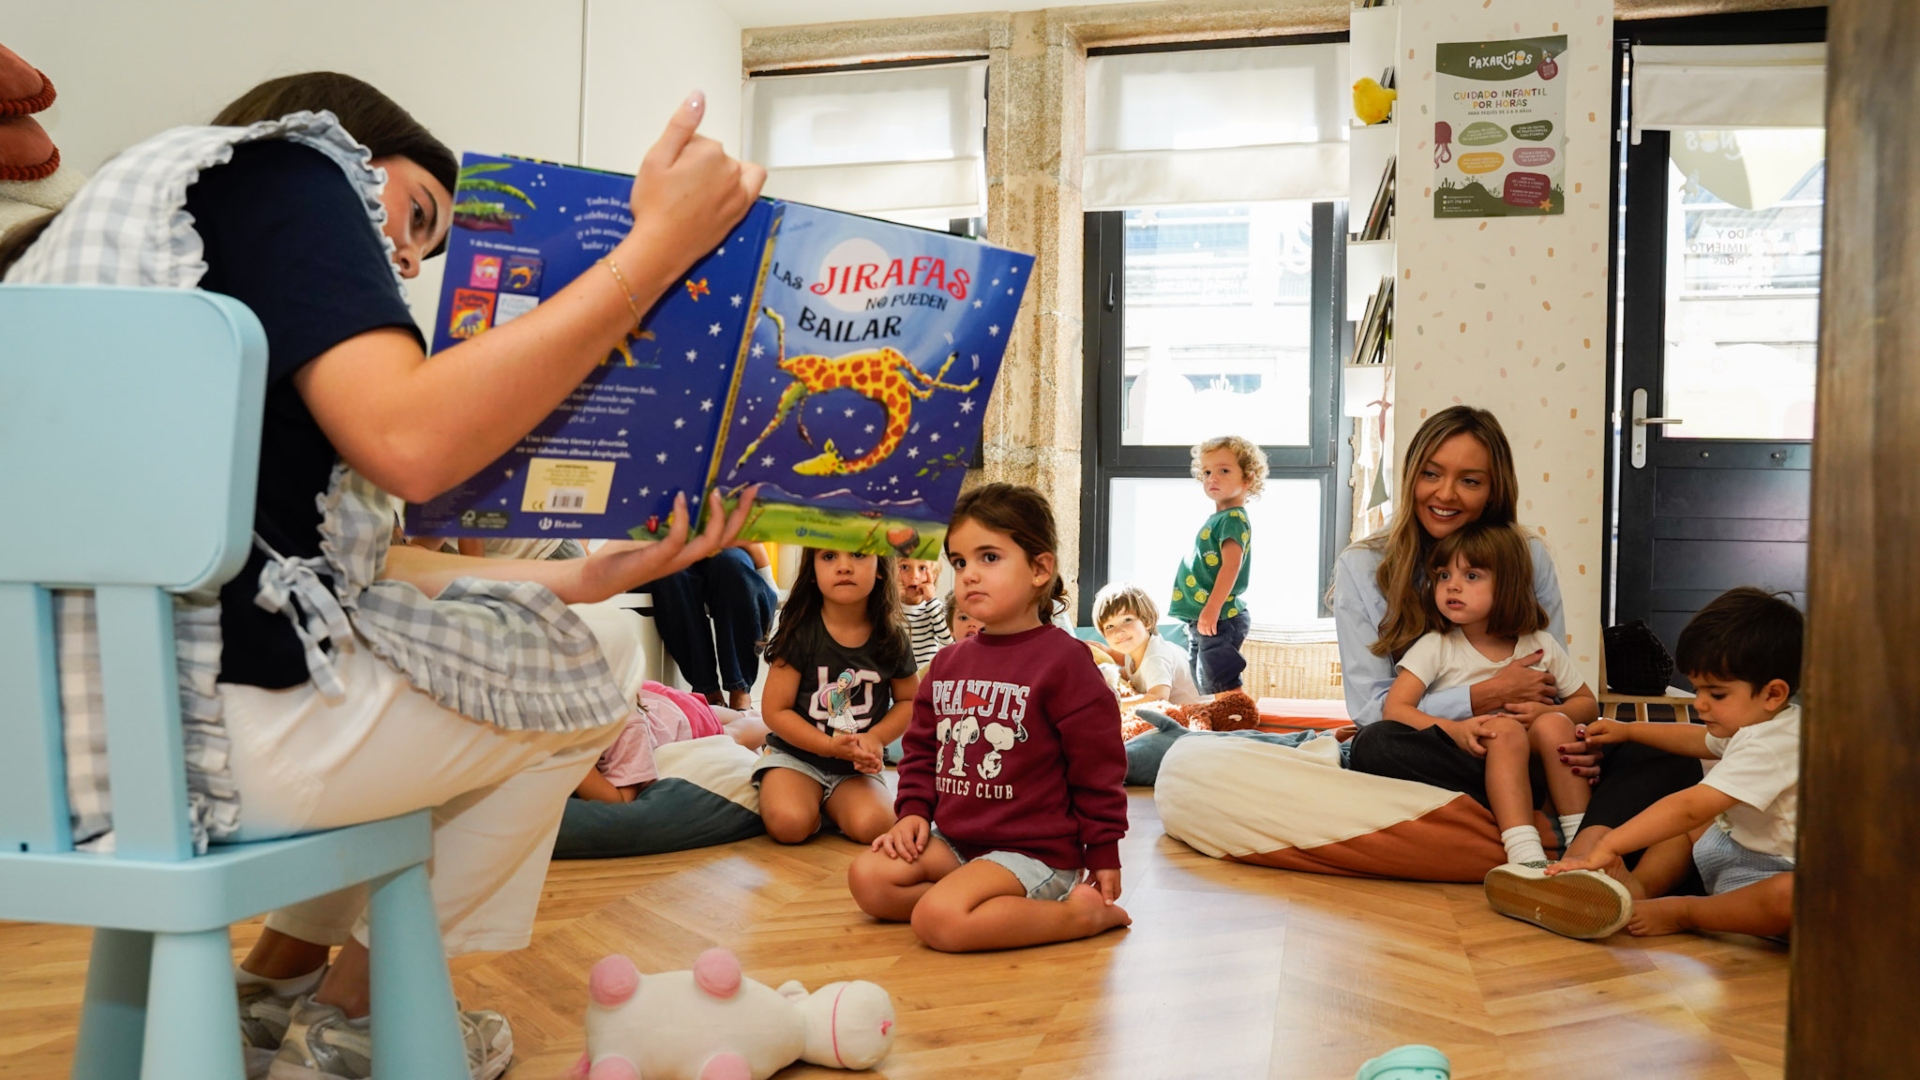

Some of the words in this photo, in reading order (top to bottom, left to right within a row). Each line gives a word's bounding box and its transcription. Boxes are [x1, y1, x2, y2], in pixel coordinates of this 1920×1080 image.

[1454, 90, 1498, 101] CUIDADO
[1502, 87, 1547, 98] INFANTIL
[1473, 100, 1492, 109] POR
[1496, 99, 1528, 108] HORAS
[773, 262, 803, 290] LAS
[810, 256, 971, 301] JIRAFAS
[866, 297, 888, 312] NO
[890, 292, 948, 312] PUEDEN
[798, 306, 902, 343] BAILAR
[932, 680, 1030, 720] PEANUTS
[976, 782, 1014, 800] CLUB
